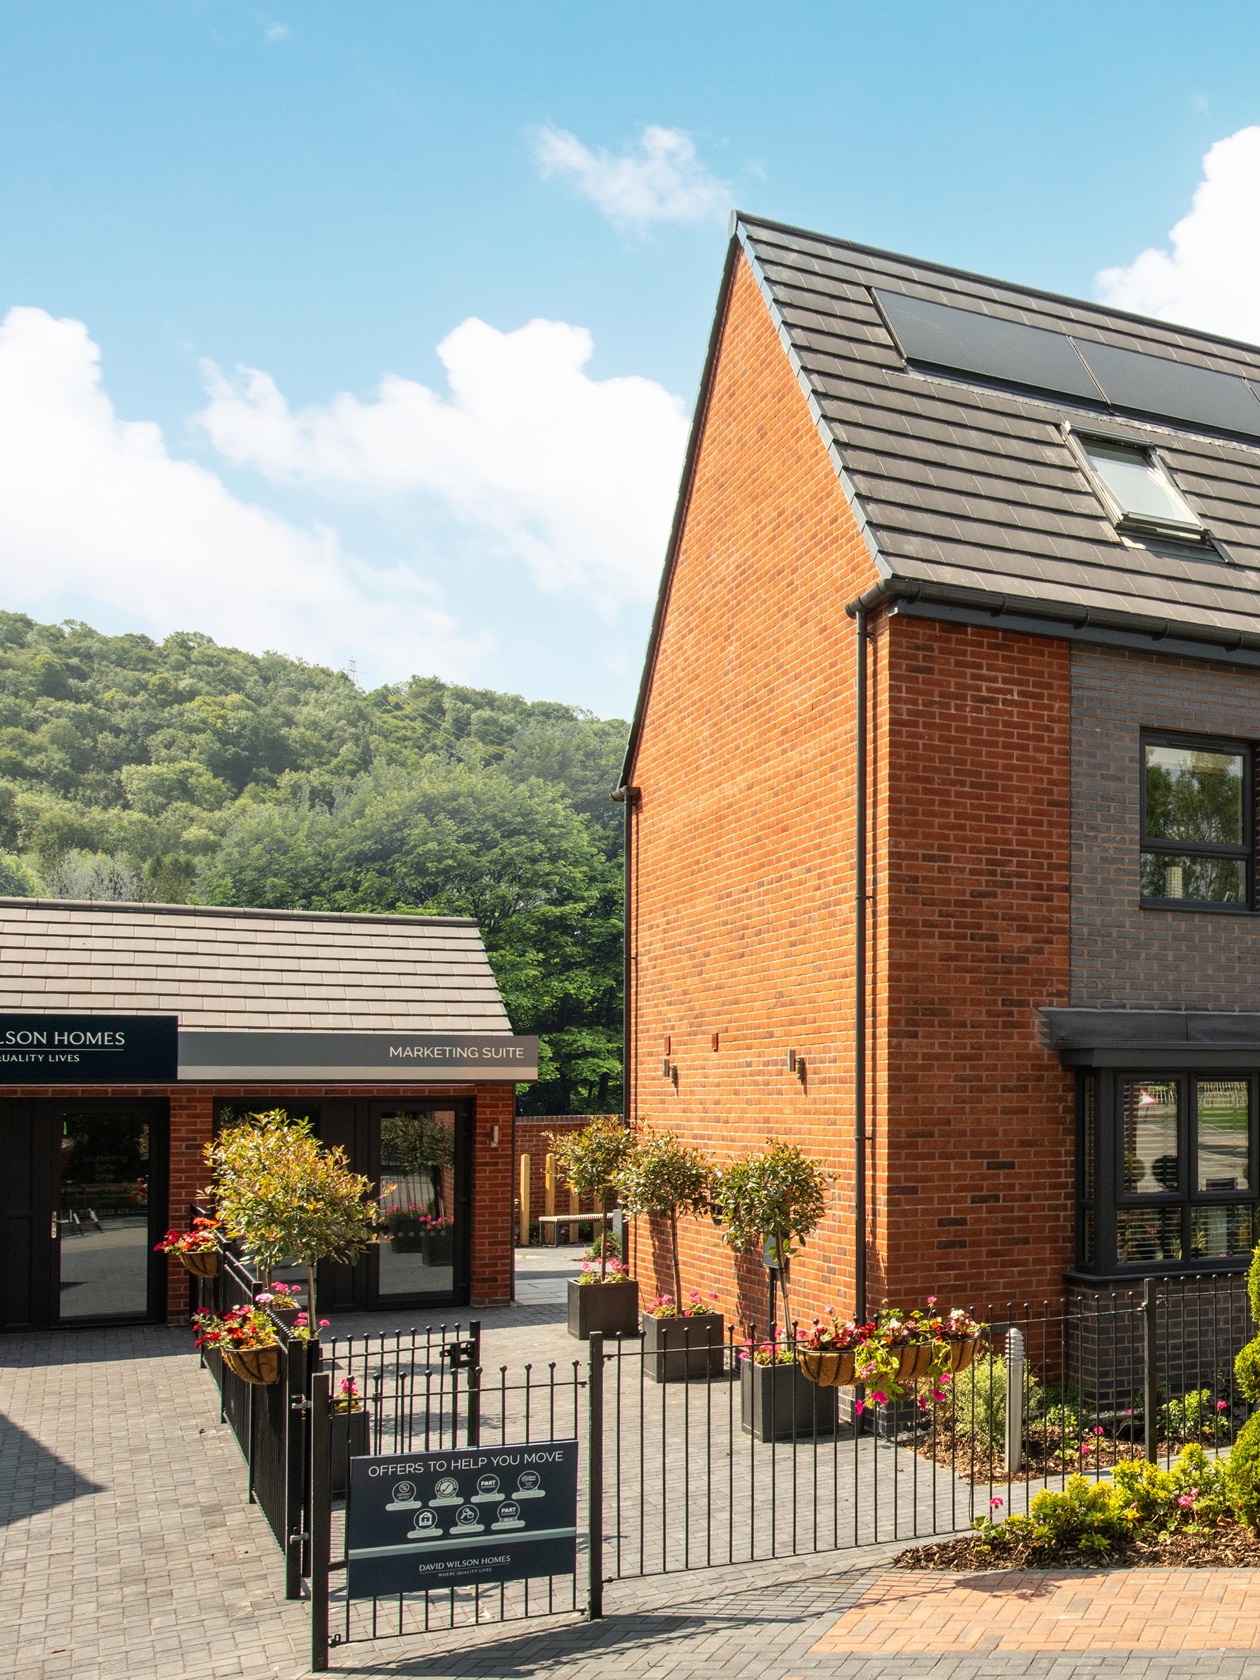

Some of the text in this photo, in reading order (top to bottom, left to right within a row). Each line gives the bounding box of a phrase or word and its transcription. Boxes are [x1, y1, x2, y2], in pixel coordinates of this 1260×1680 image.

[54, 1031, 125, 1046] HOMES
[48, 1054, 80, 1062] LIVES
[390, 1046, 525, 1058] MARKETING SUITE
[369, 1451, 563, 1476] OFFERS TO HELP YOU MOVE
[419, 1555, 511, 1571] DAVID WILSON HOMES
